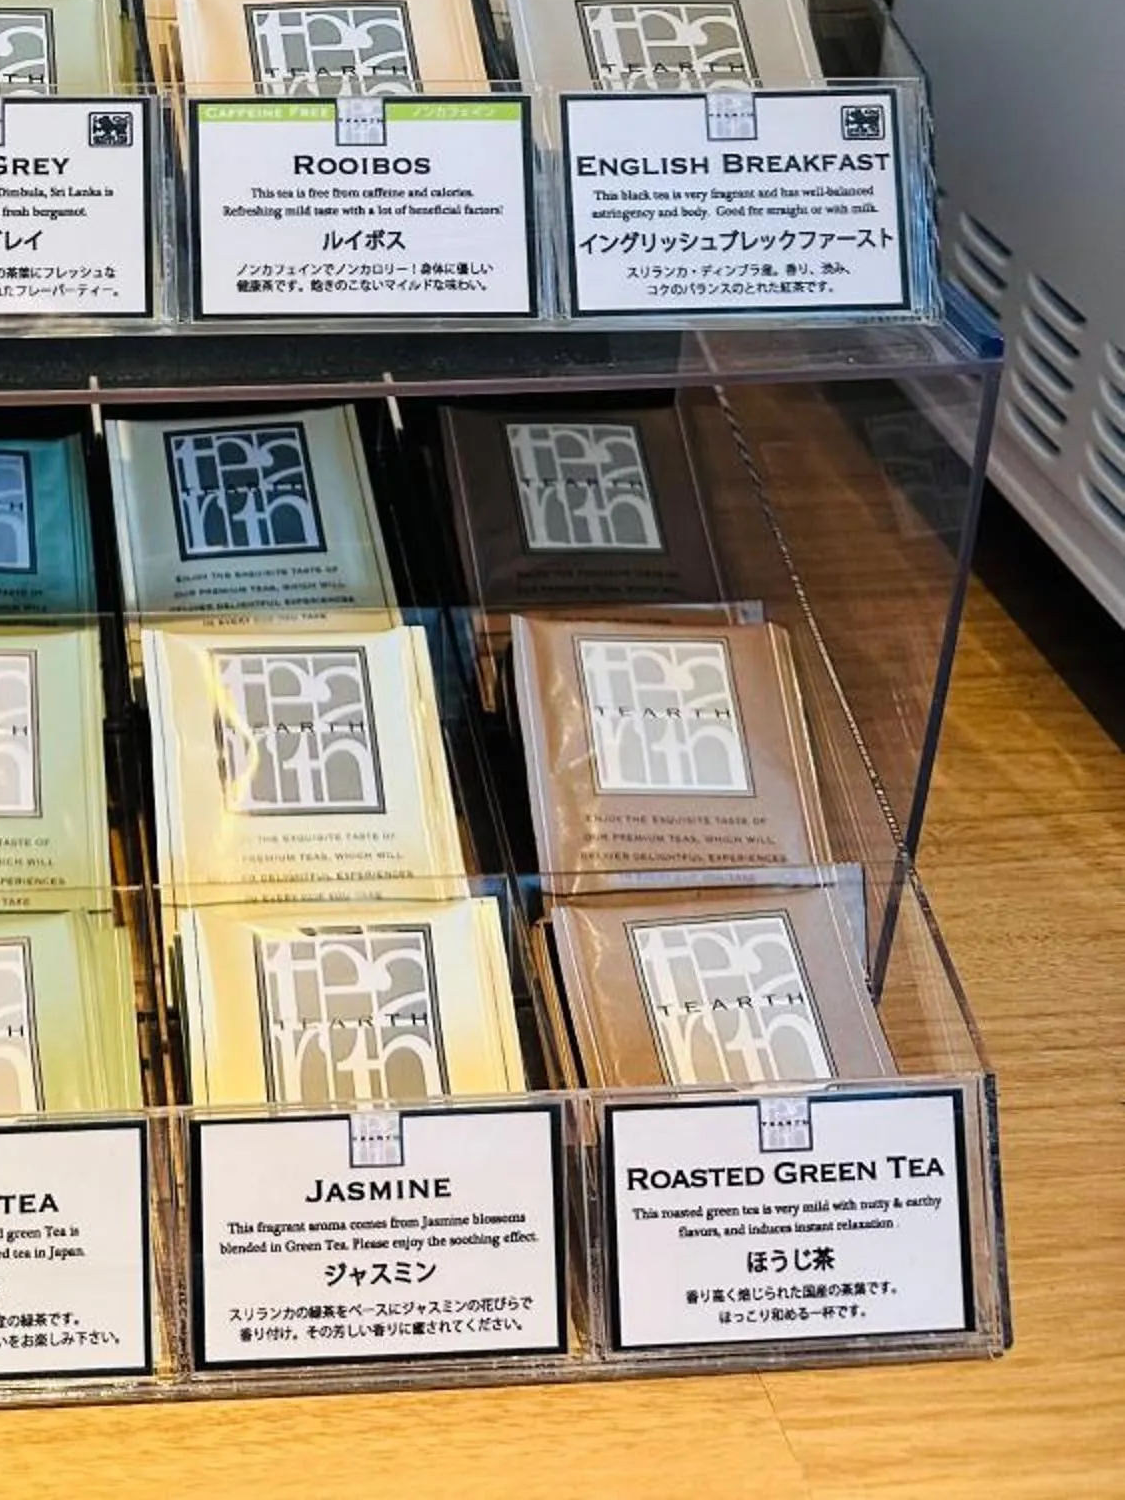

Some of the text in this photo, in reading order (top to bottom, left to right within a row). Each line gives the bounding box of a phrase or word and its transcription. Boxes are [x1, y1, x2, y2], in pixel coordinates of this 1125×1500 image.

[264, 65, 410, 77] TEARTH
[601, 62, 746, 74] TEARTH
[293, 154, 431, 175] ROOIBOS
[576, 152, 890, 177] ENGLISH BREAKFAST
[322, 229, 406, 250] ルイボス
[579, 227, 893, 255] イングリッシュブレックファースト
[595, 707, 731, 718] TEARTH
[657, 992, 805, 1016] TEARTH
[274, 1012, 429, 1030] TEARTH
[626, 1155, 944, 1191] ROASTED GREEN TEA
[305, 1177, 451, 1203] JASMINE
[746, 1247, 835, 1274] ほうじ茶
[324, 1260, 436, 1288] ジャスミン
